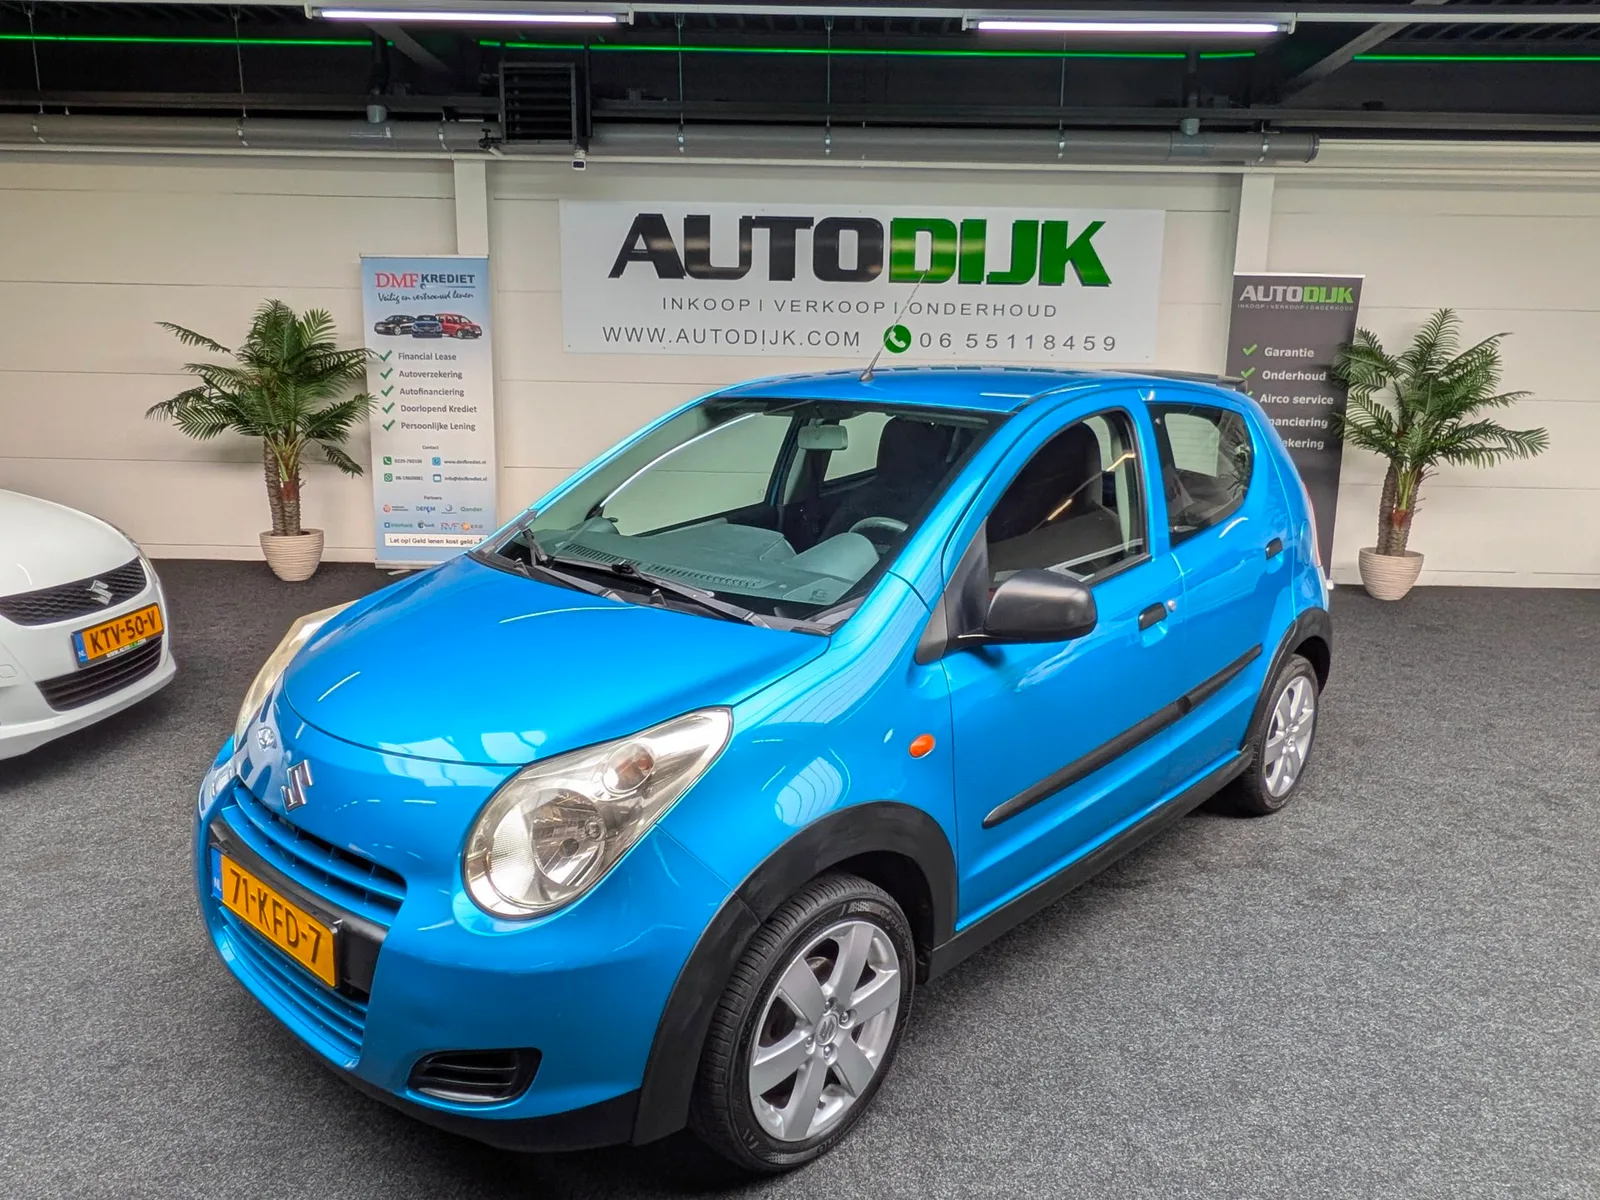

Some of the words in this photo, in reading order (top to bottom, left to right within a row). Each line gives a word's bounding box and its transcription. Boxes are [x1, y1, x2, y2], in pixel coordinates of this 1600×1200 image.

[608, 213, 1112, 287] AUTODIJK
[375, 273, 418, 288] DMF
[421, 274, 475, 284] KREDIET
[378, 292, 400, 304] Veilig
[413, 291, 451, 300] vertrouwd
[452, 290, 474, 299] lenen
[1240, 285, 1354, 303] AUTODIJK
[662, 297, 750, 311] INKOOP
[774, 299, 886, 314] VERKOOP
[909, 302, 1057, 317] ONDERHOUD
[602, 326, 860, 346] WWW.AUTODIJK.COM
[919, 332, 952, 348] 06
[965, 333, 1116, 351] 55118459
[398, 352, 433, 361] Financial
[434, 352, 457, 361] Lease
[1264, 347, 1315, 357] Garantie
[398, 369, 463, 380] Autoverzekering
[1261, 370, 1327, 381] Onderhoud
[399, 388, 465, 398] Autofinanciering
[1260, 393, 1290, 404] Airco
[1292, 395, 1334, 405] service
[401, 405, 447, 415] Doorlopend
[448, 405, 477, 413] Krediet
[401, 422, 449, 433] Persoonlijke
[450, 423, 476, 432] Lening
[401, 537, 411, 546] op!
[460, 538, 473, 546] geld
[89, 609, 156, 654] KTV-50-V
[230, 867, 322, 965] 71-KFD-7
